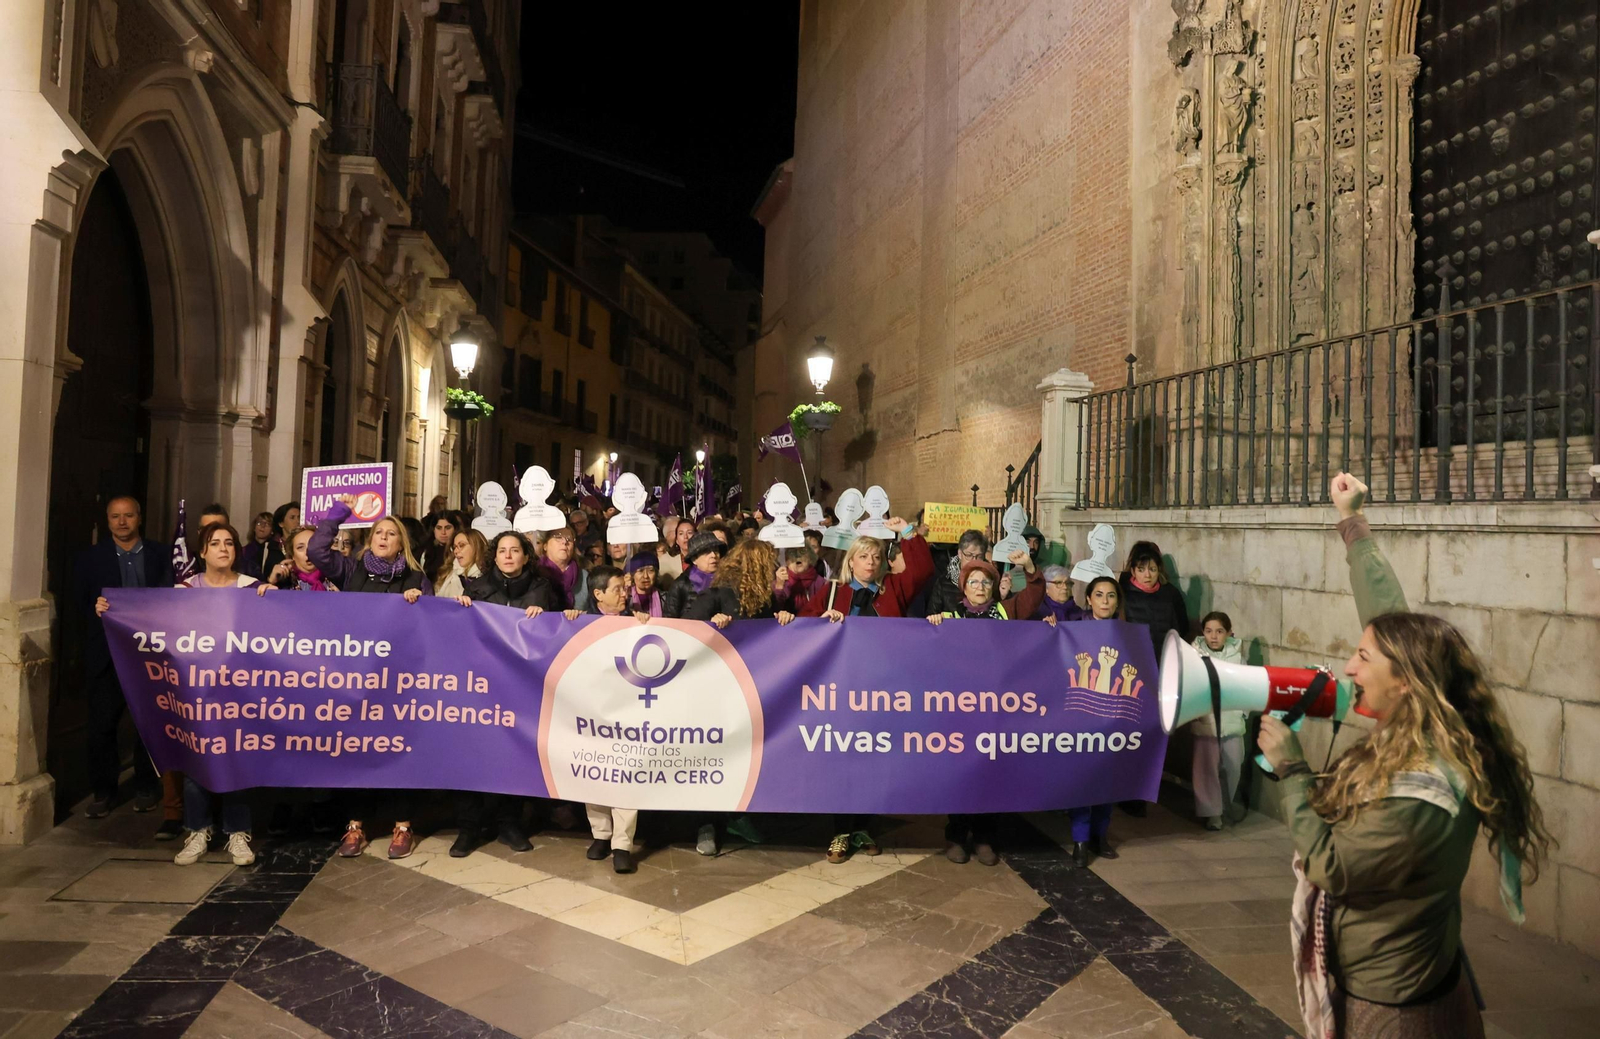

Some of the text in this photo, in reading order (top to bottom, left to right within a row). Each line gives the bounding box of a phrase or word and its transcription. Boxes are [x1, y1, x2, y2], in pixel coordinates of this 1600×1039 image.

[311, 472, 382, 489] EL MACHISMO
[310, 492, 347, 513] MAT
[132, 630, 392, 658] 25 de Noviembre
[144, 660, 489, 695] Día Internacional para la
[156, 691, 516, 728] eliminación de la violencia
[801, 682, 1047, 717] Ni una menos,
[164, 723, 413, 758] contra las mujeres.
[575, 716, 724, 744] Plataforma
[798, 723, 1143, 761] Vivas nos queremos
[572, 748, 724, 768] violencias machistas
[611, 742, 681, 757] contra las
[570, 763, 724, 785] VIOLENCIA CERO
